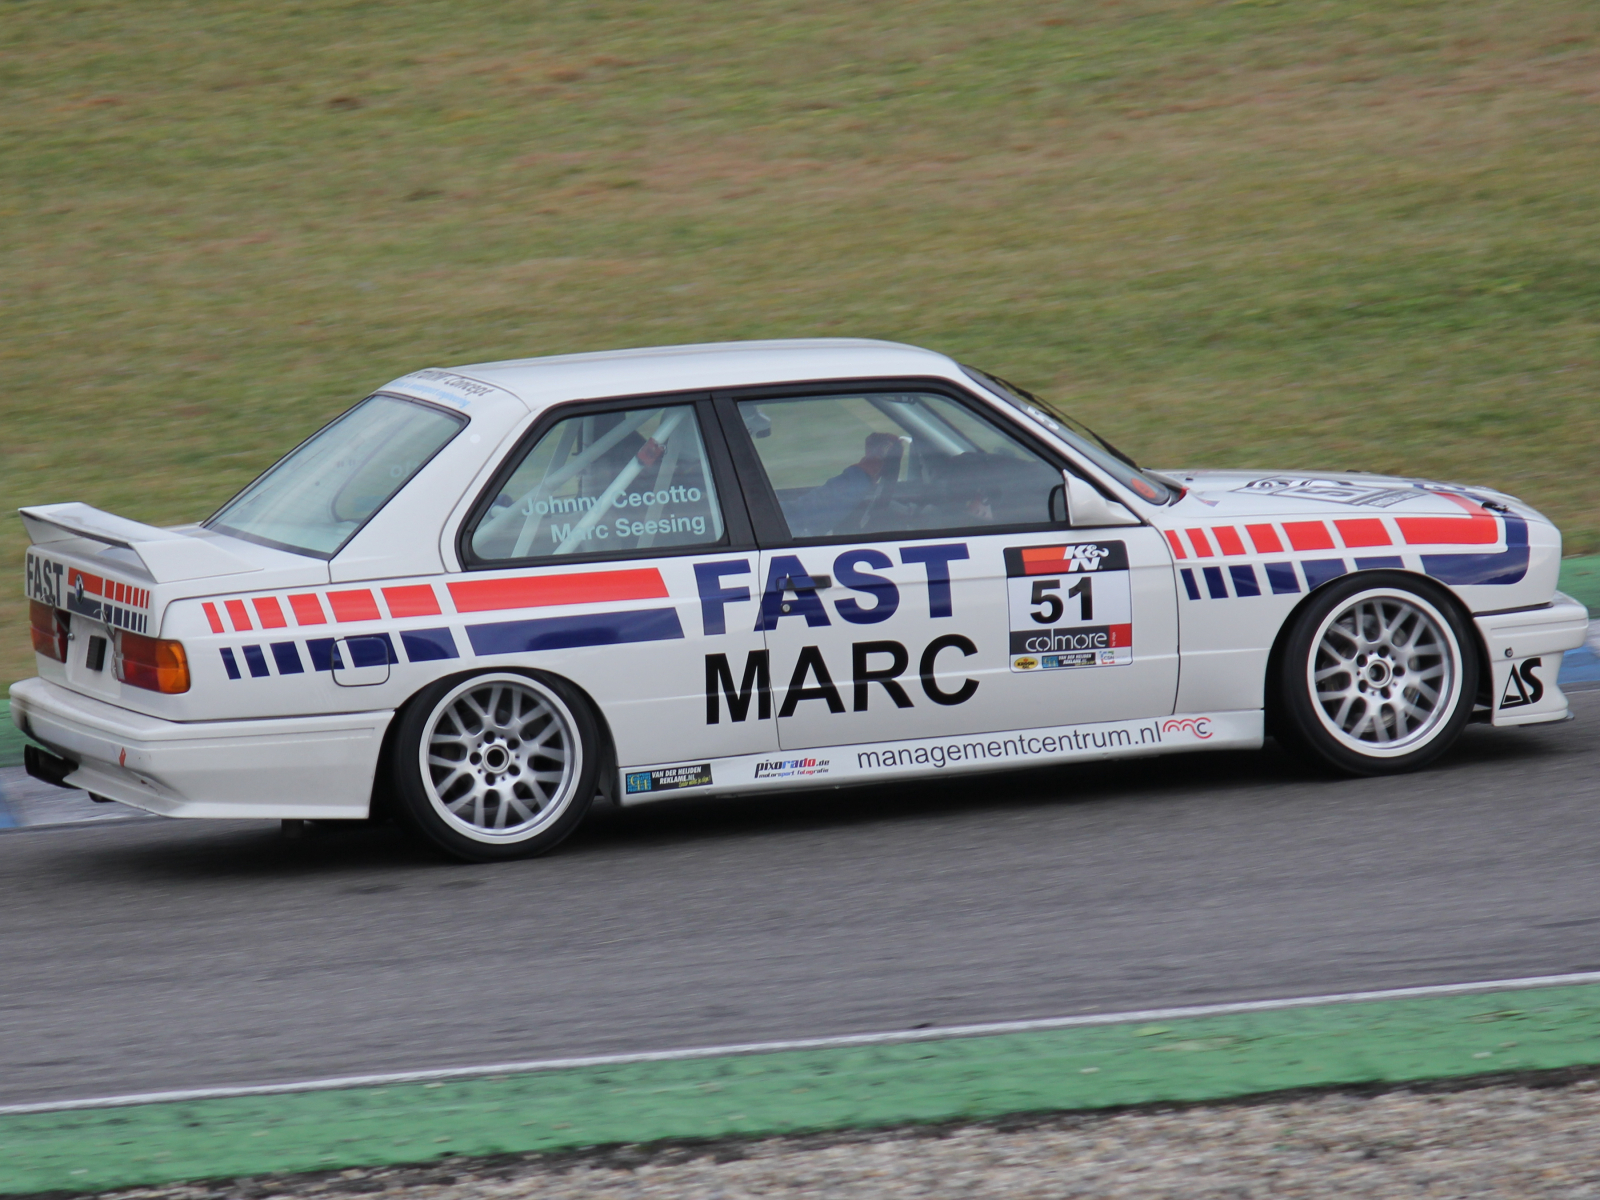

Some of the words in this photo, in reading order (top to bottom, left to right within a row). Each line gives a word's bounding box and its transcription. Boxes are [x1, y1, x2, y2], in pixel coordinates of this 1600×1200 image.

[522, 495, 601, 517] Johnny
[612, 485, 701, 509] Cecotto
[615, 514, 706, 538] Seesing
[27, 553, 63, 607] FAST
[693, 543, 970, 636] FAST
[1030, 576, 1093, 625] 51
[1025, 628, 1107, 652] colmore
[705, 633, 980, 725] MARC
[857, 721, 1162, 768] managementcentrum.nl
[652, 770, 664, 778] VAN
[754, 757, 830, 779] pixorado.de
